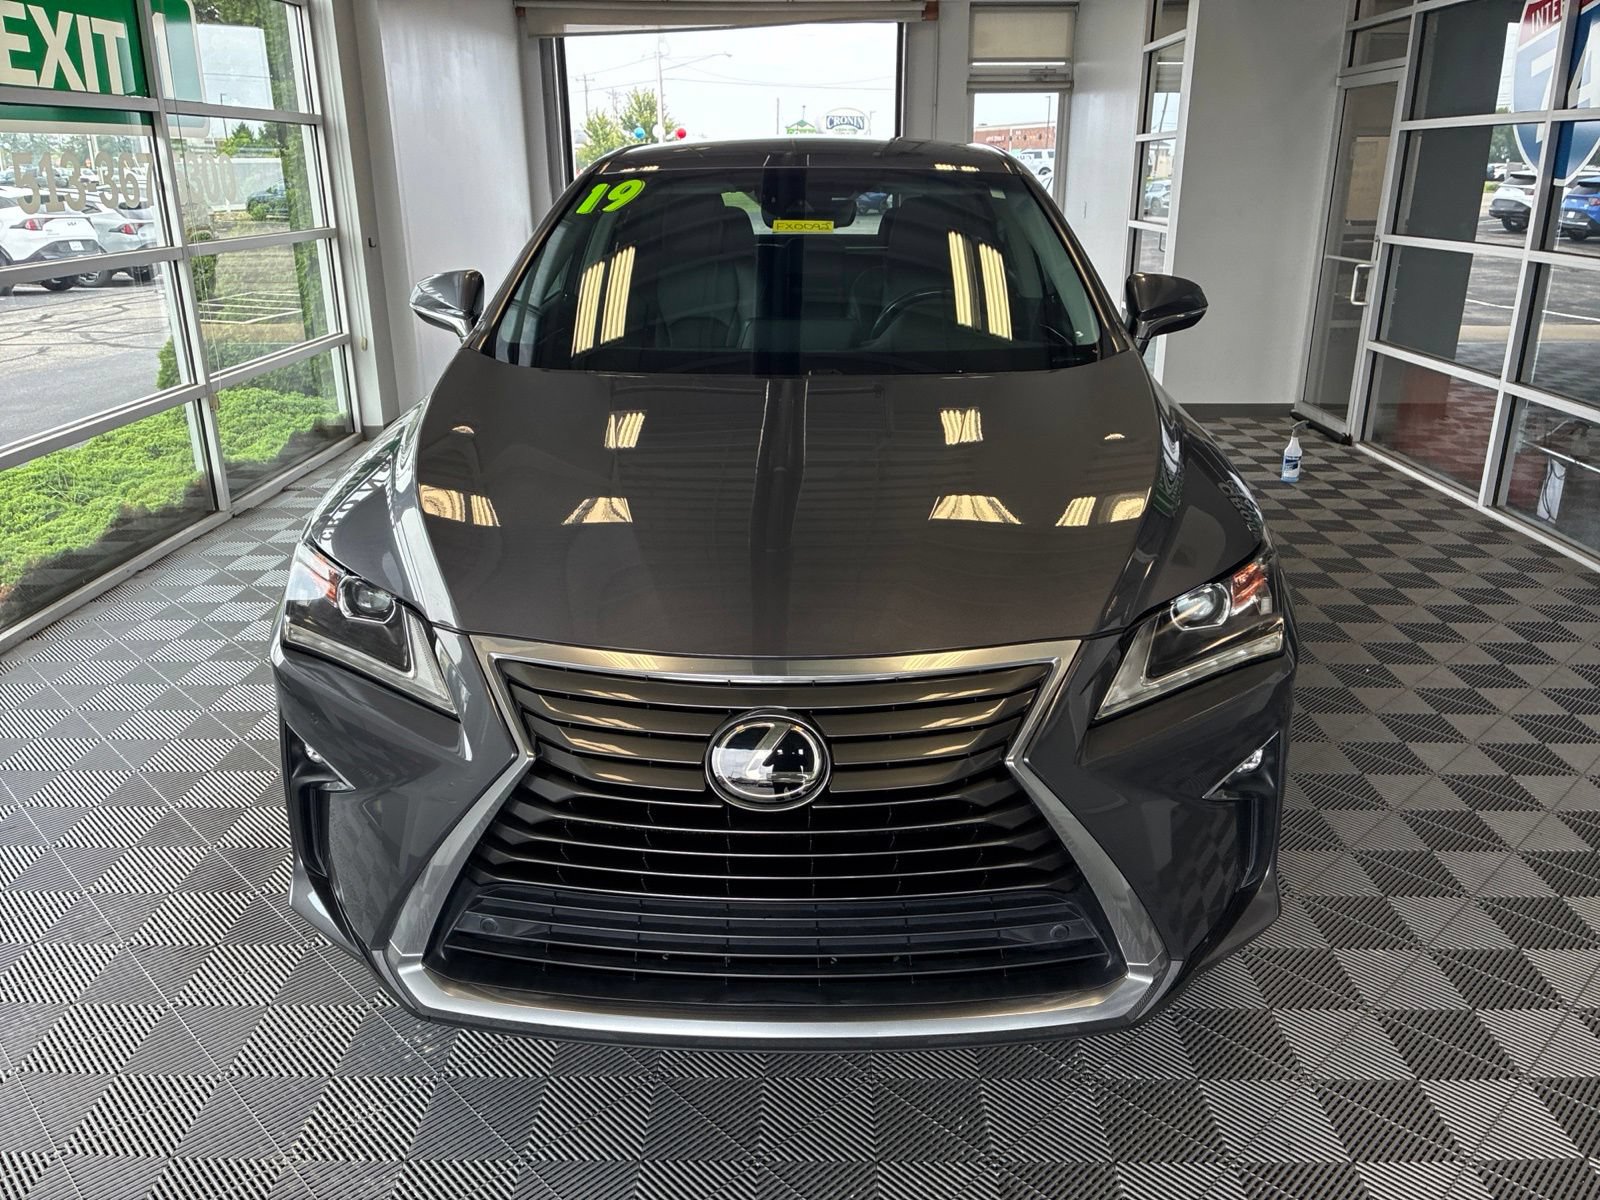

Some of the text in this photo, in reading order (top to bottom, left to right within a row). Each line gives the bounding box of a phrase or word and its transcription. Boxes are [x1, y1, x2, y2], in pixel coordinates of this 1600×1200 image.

[1531, 0, 1563, 34] INTE
[0, 1, 126, 96] EXIT
[826, 115, 865, 130] CRONIN
[575, 179, 646, 215] 19
